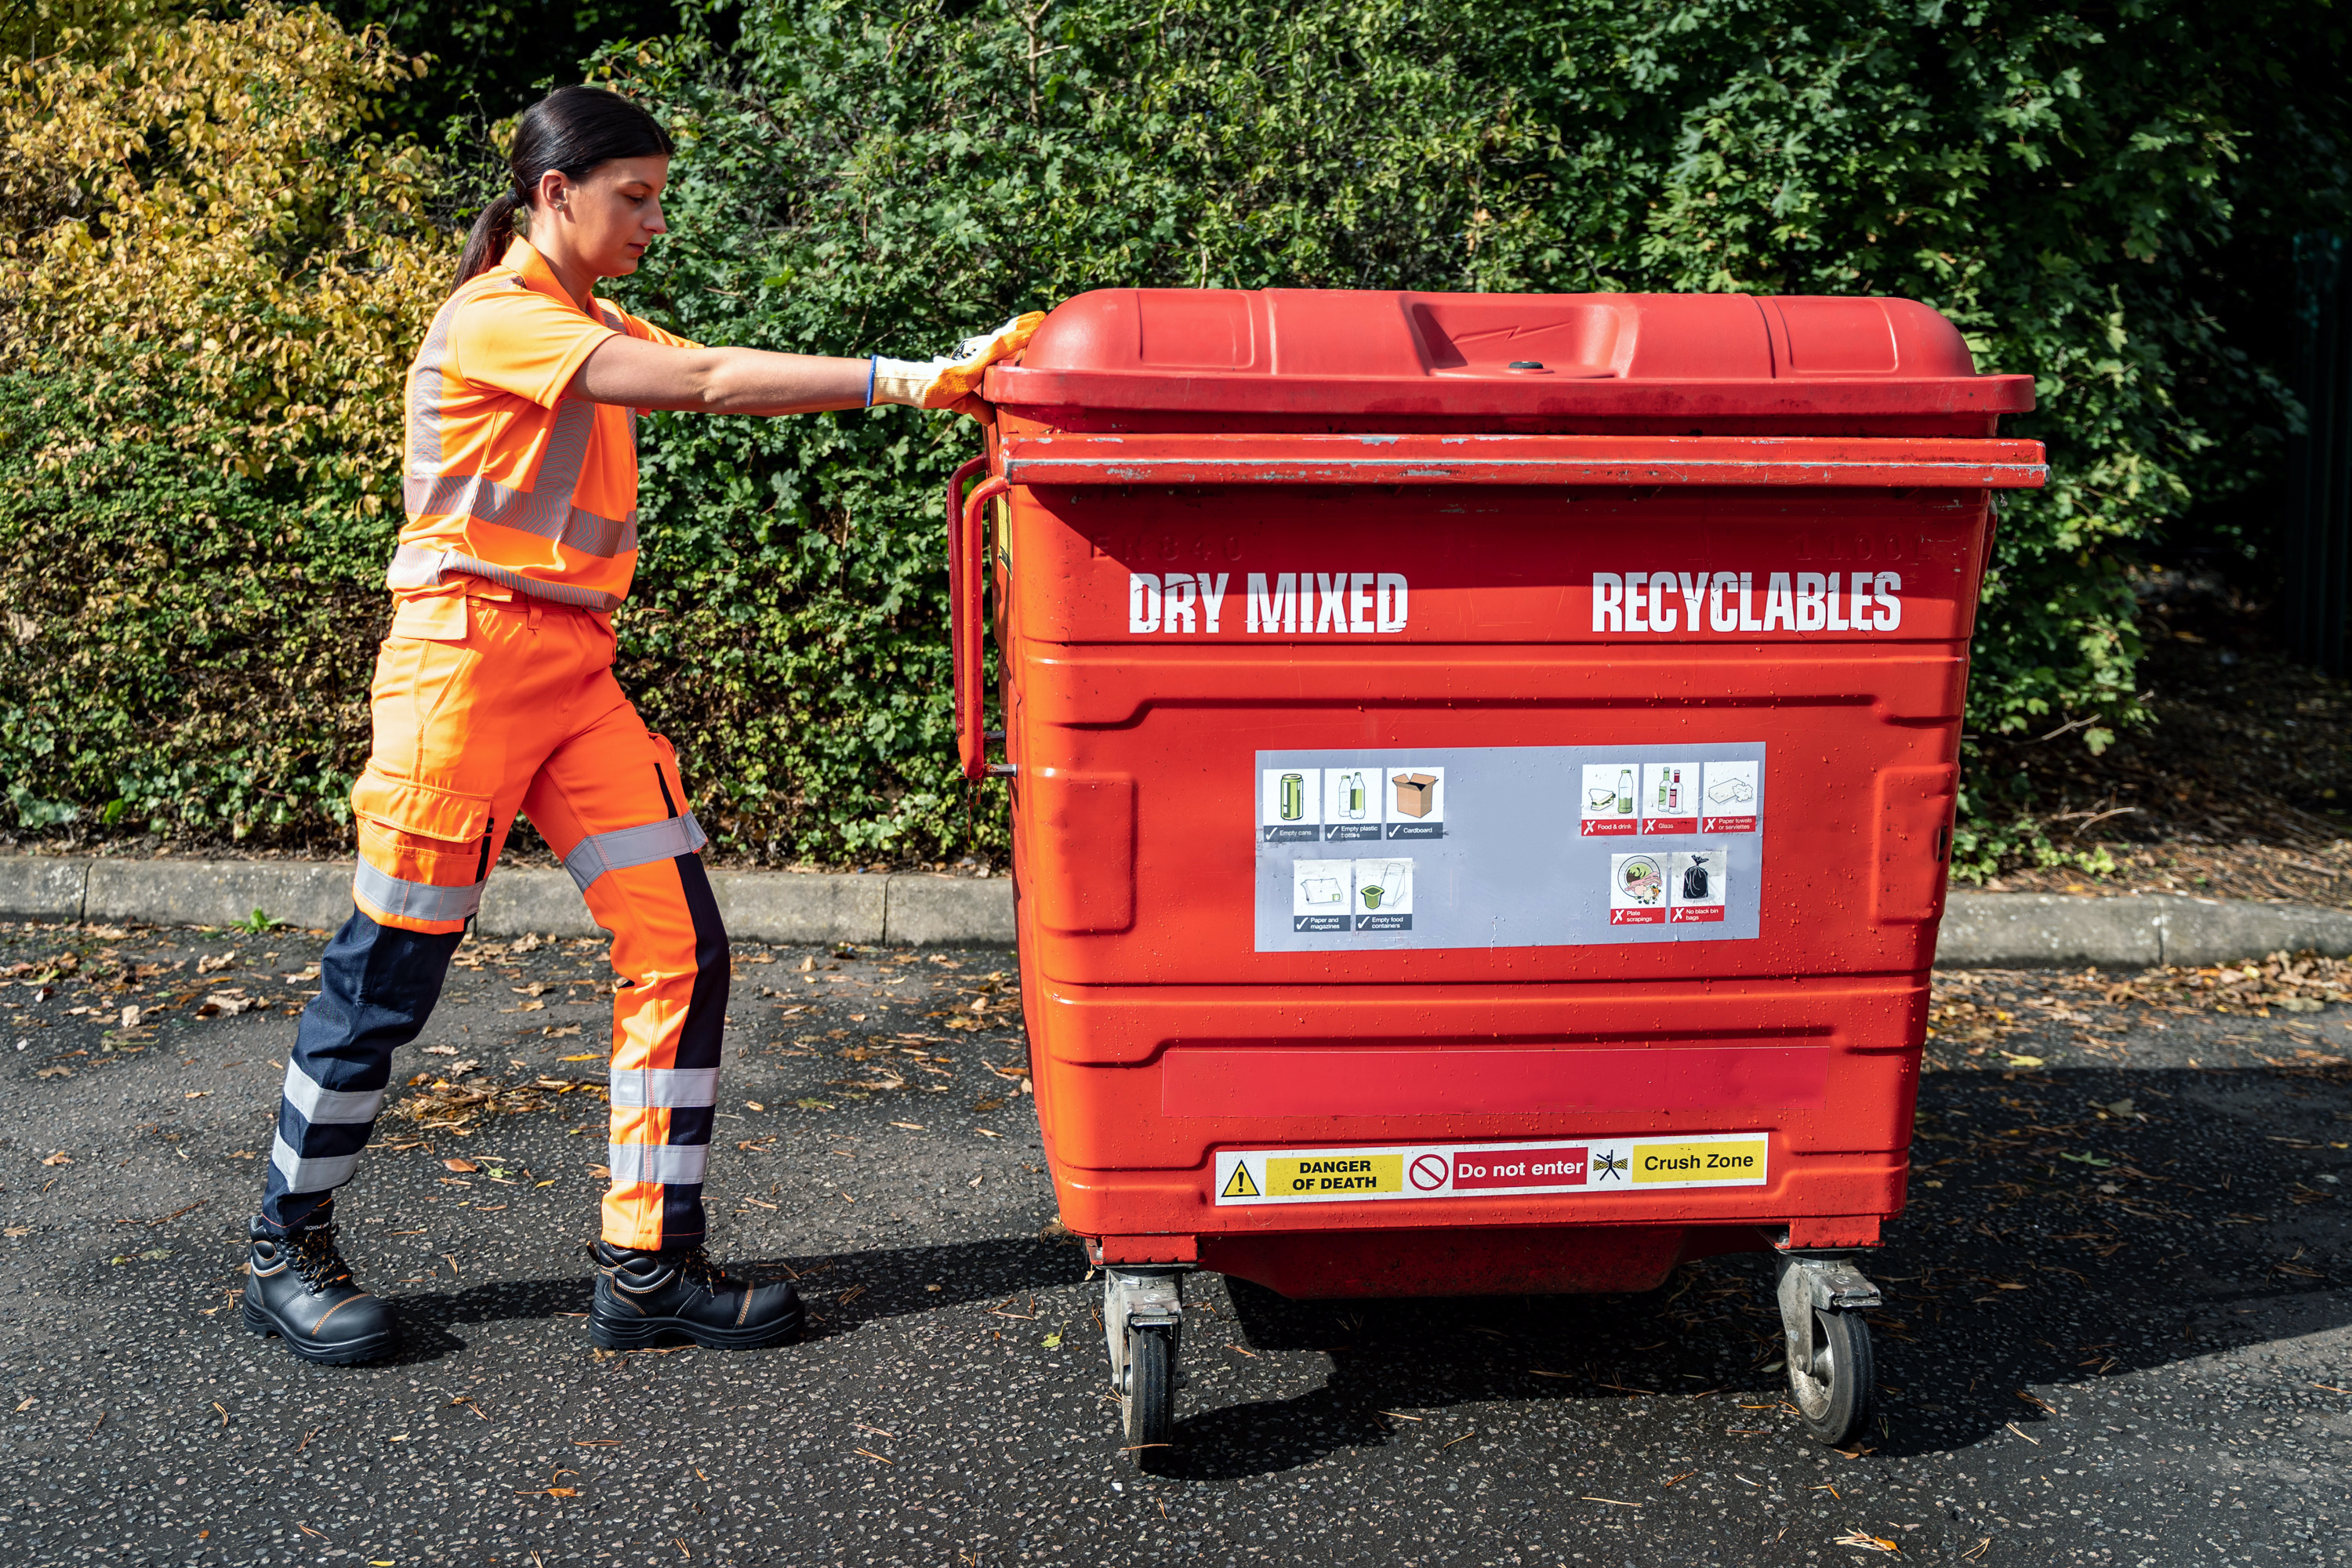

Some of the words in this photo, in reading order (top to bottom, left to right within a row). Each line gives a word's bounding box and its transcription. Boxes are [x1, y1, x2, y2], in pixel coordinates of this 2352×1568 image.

[1129, 573, 1229, 633] DRY
[1247, 573, 1408, 633] MIXED
[1592, 572, 1901, 633] RECYCLABLES
[1300, 1160, 1371, 1174] DANGER
[1458, 1163, 1486, 1178] Do
[1493, 1162, 1526, 1177] not
[1531, 1160, 1584, 1176] enter
[1645, 1155, 1700, 1171] Crush
[1707, 1154, 1754, 1168] Zone
[1293, 1178, 1316, 1191] OF
[1320, 1176, 1377, 1189] DEATH
